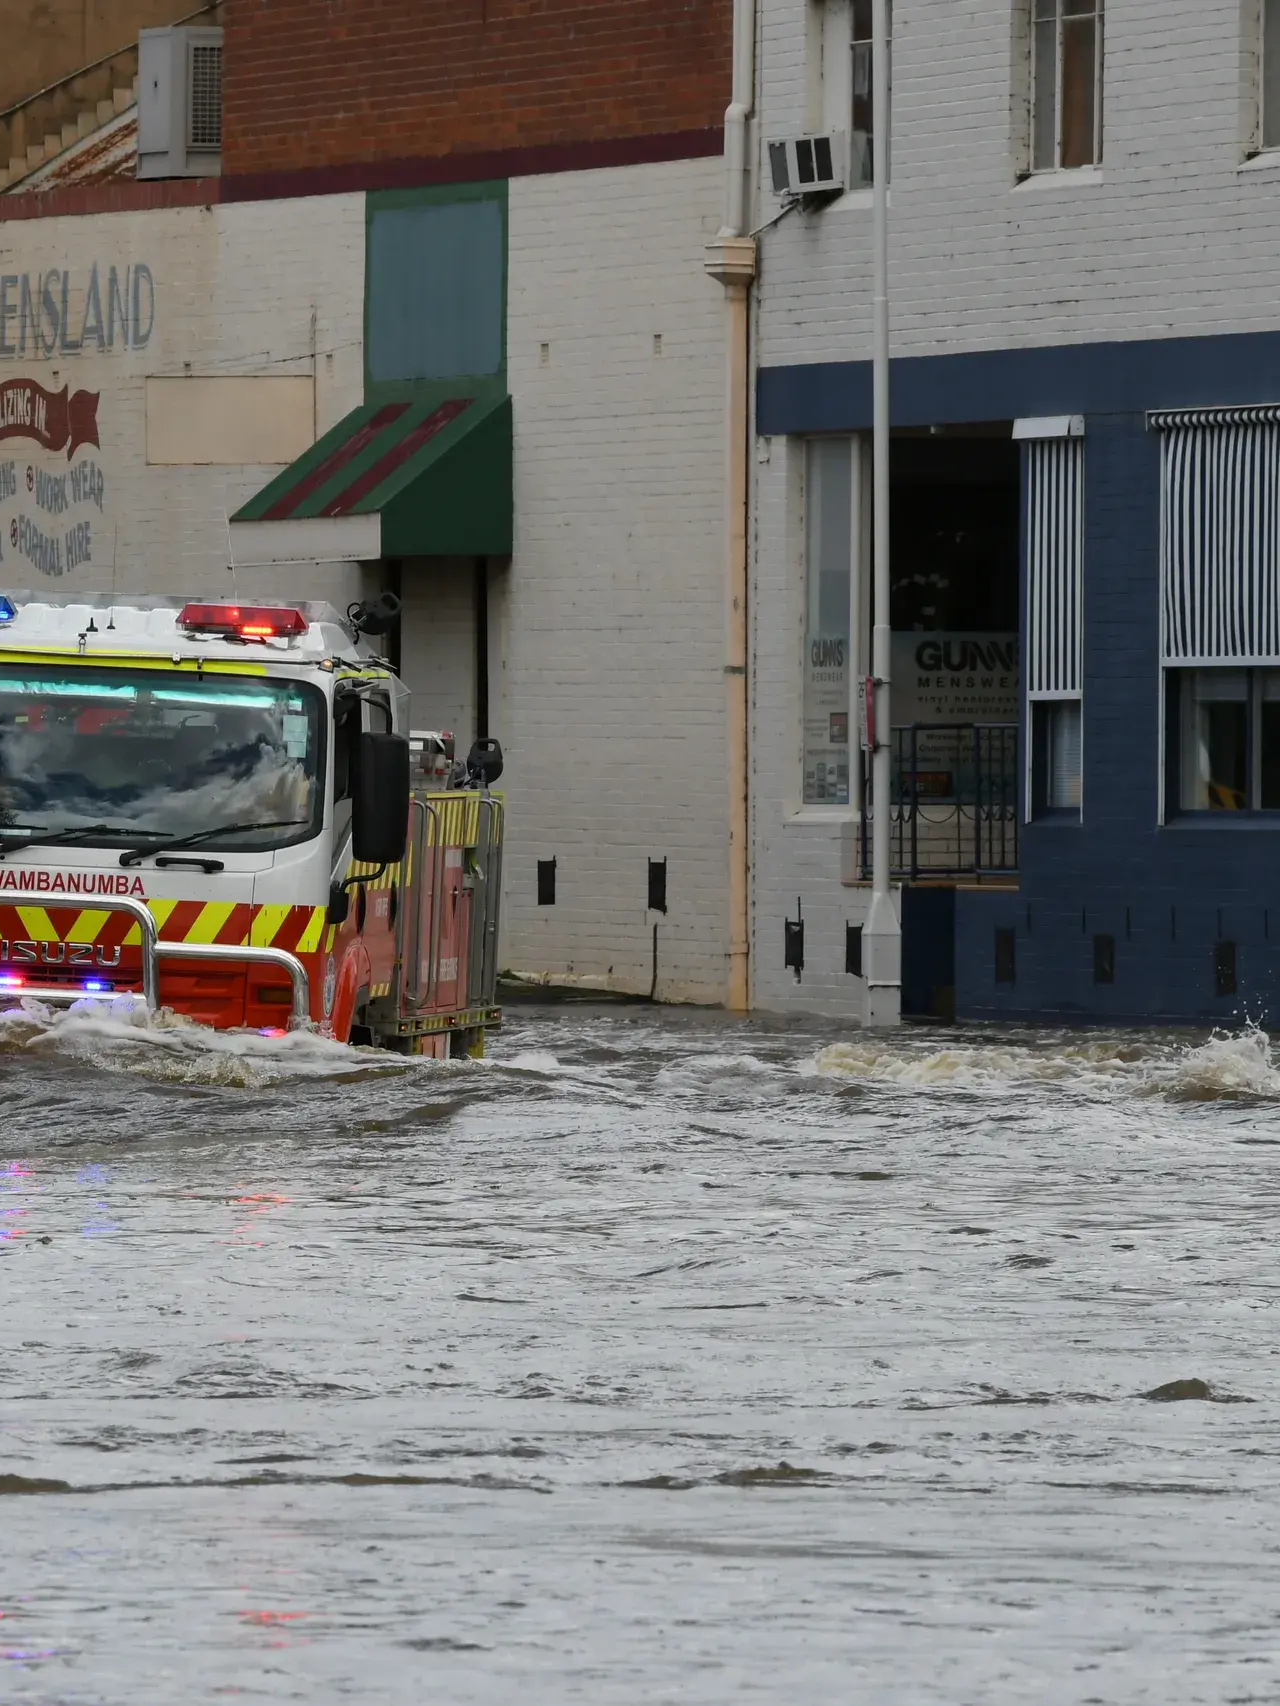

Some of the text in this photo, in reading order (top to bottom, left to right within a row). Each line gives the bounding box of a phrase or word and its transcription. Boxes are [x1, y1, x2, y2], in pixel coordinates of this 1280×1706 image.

[35, 460, 104, 514] WORK WEAR
[19, 514, 91, 577] FORMAL HIRE
[915, 640, 1016, 672] GUNN
[917, 676, 1019, 689] MENSWE
[1, 940, 121, 966] ISUZU
